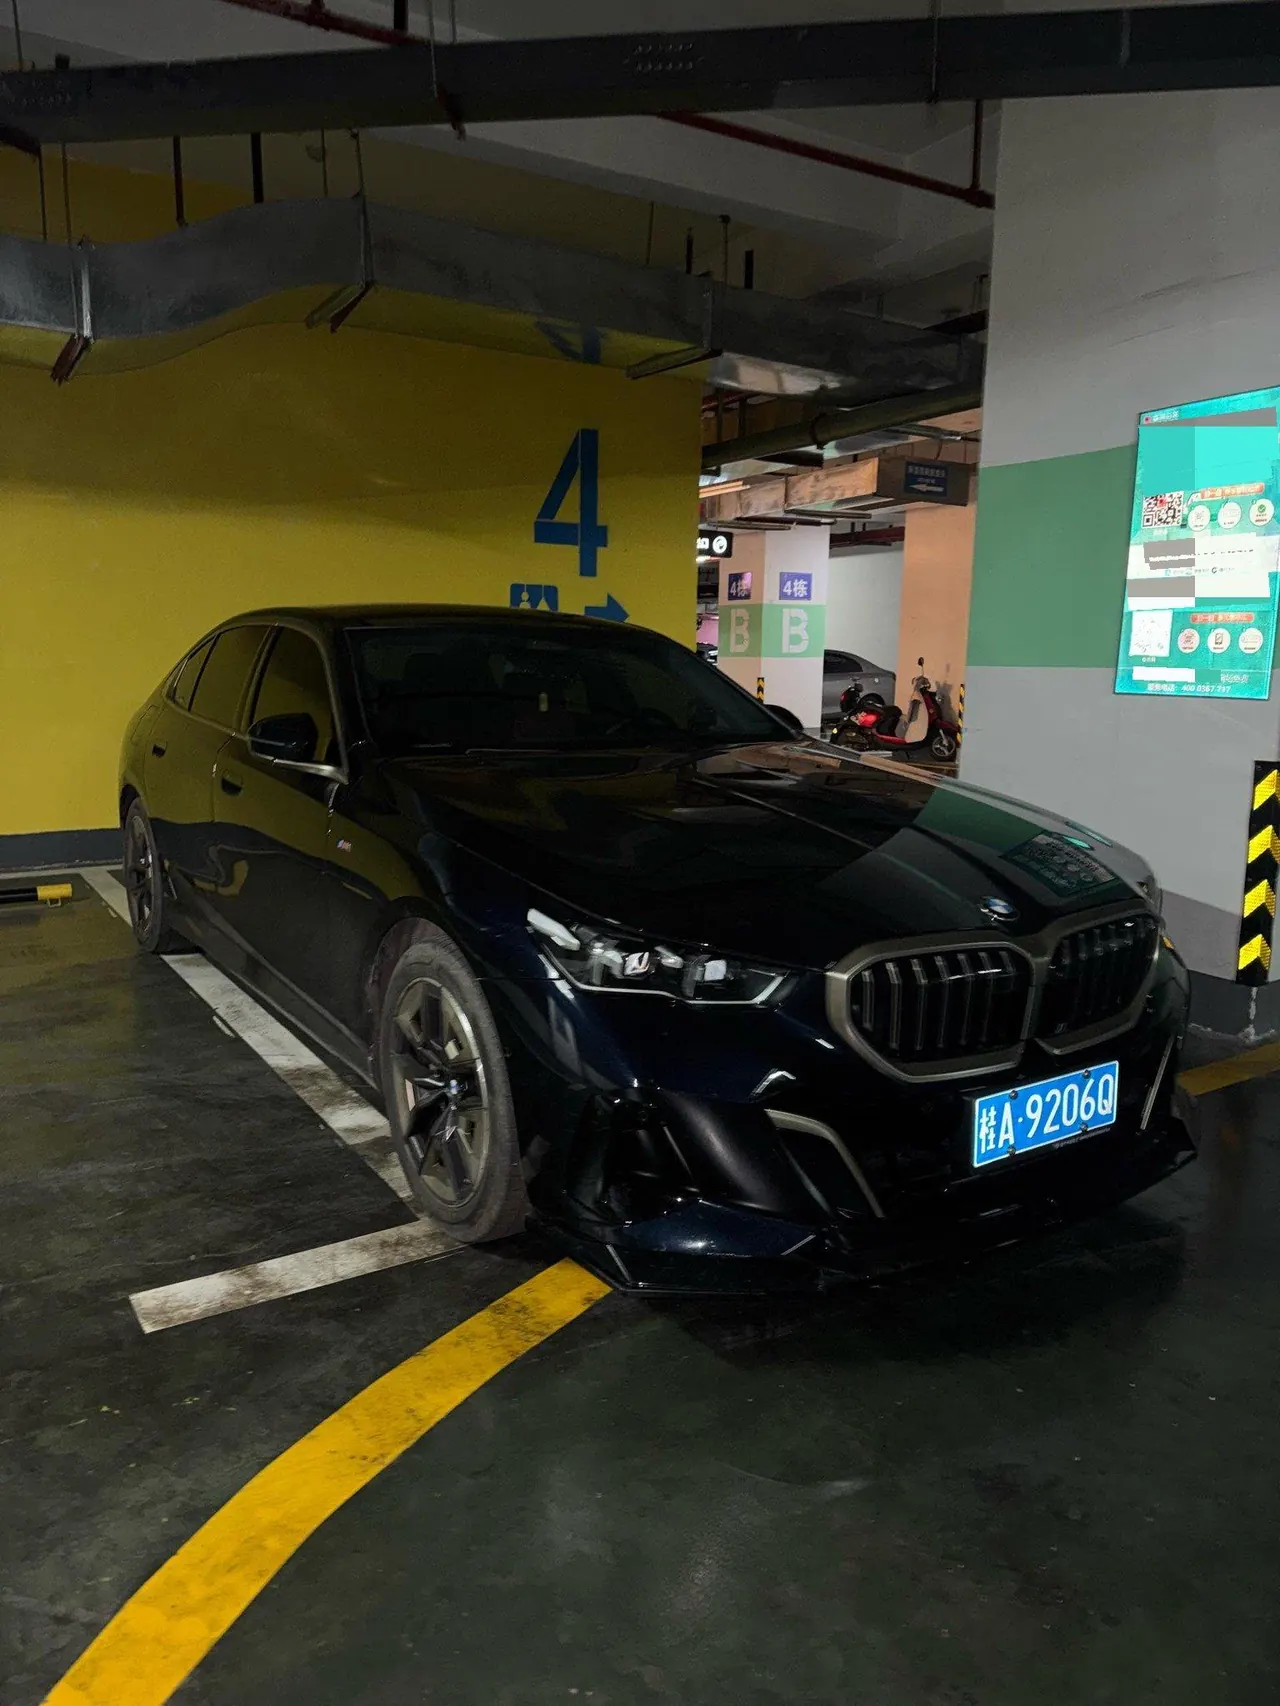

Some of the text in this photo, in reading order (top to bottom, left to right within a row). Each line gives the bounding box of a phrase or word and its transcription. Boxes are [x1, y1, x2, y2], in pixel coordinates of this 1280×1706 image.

[534, 428, 608, 577] 4
[782, 578, 808, 598] 4栋
[730, 608, 750, 653] B
[782, 608, 809, 654] B
[1181, 684, 1196, 692] 400
